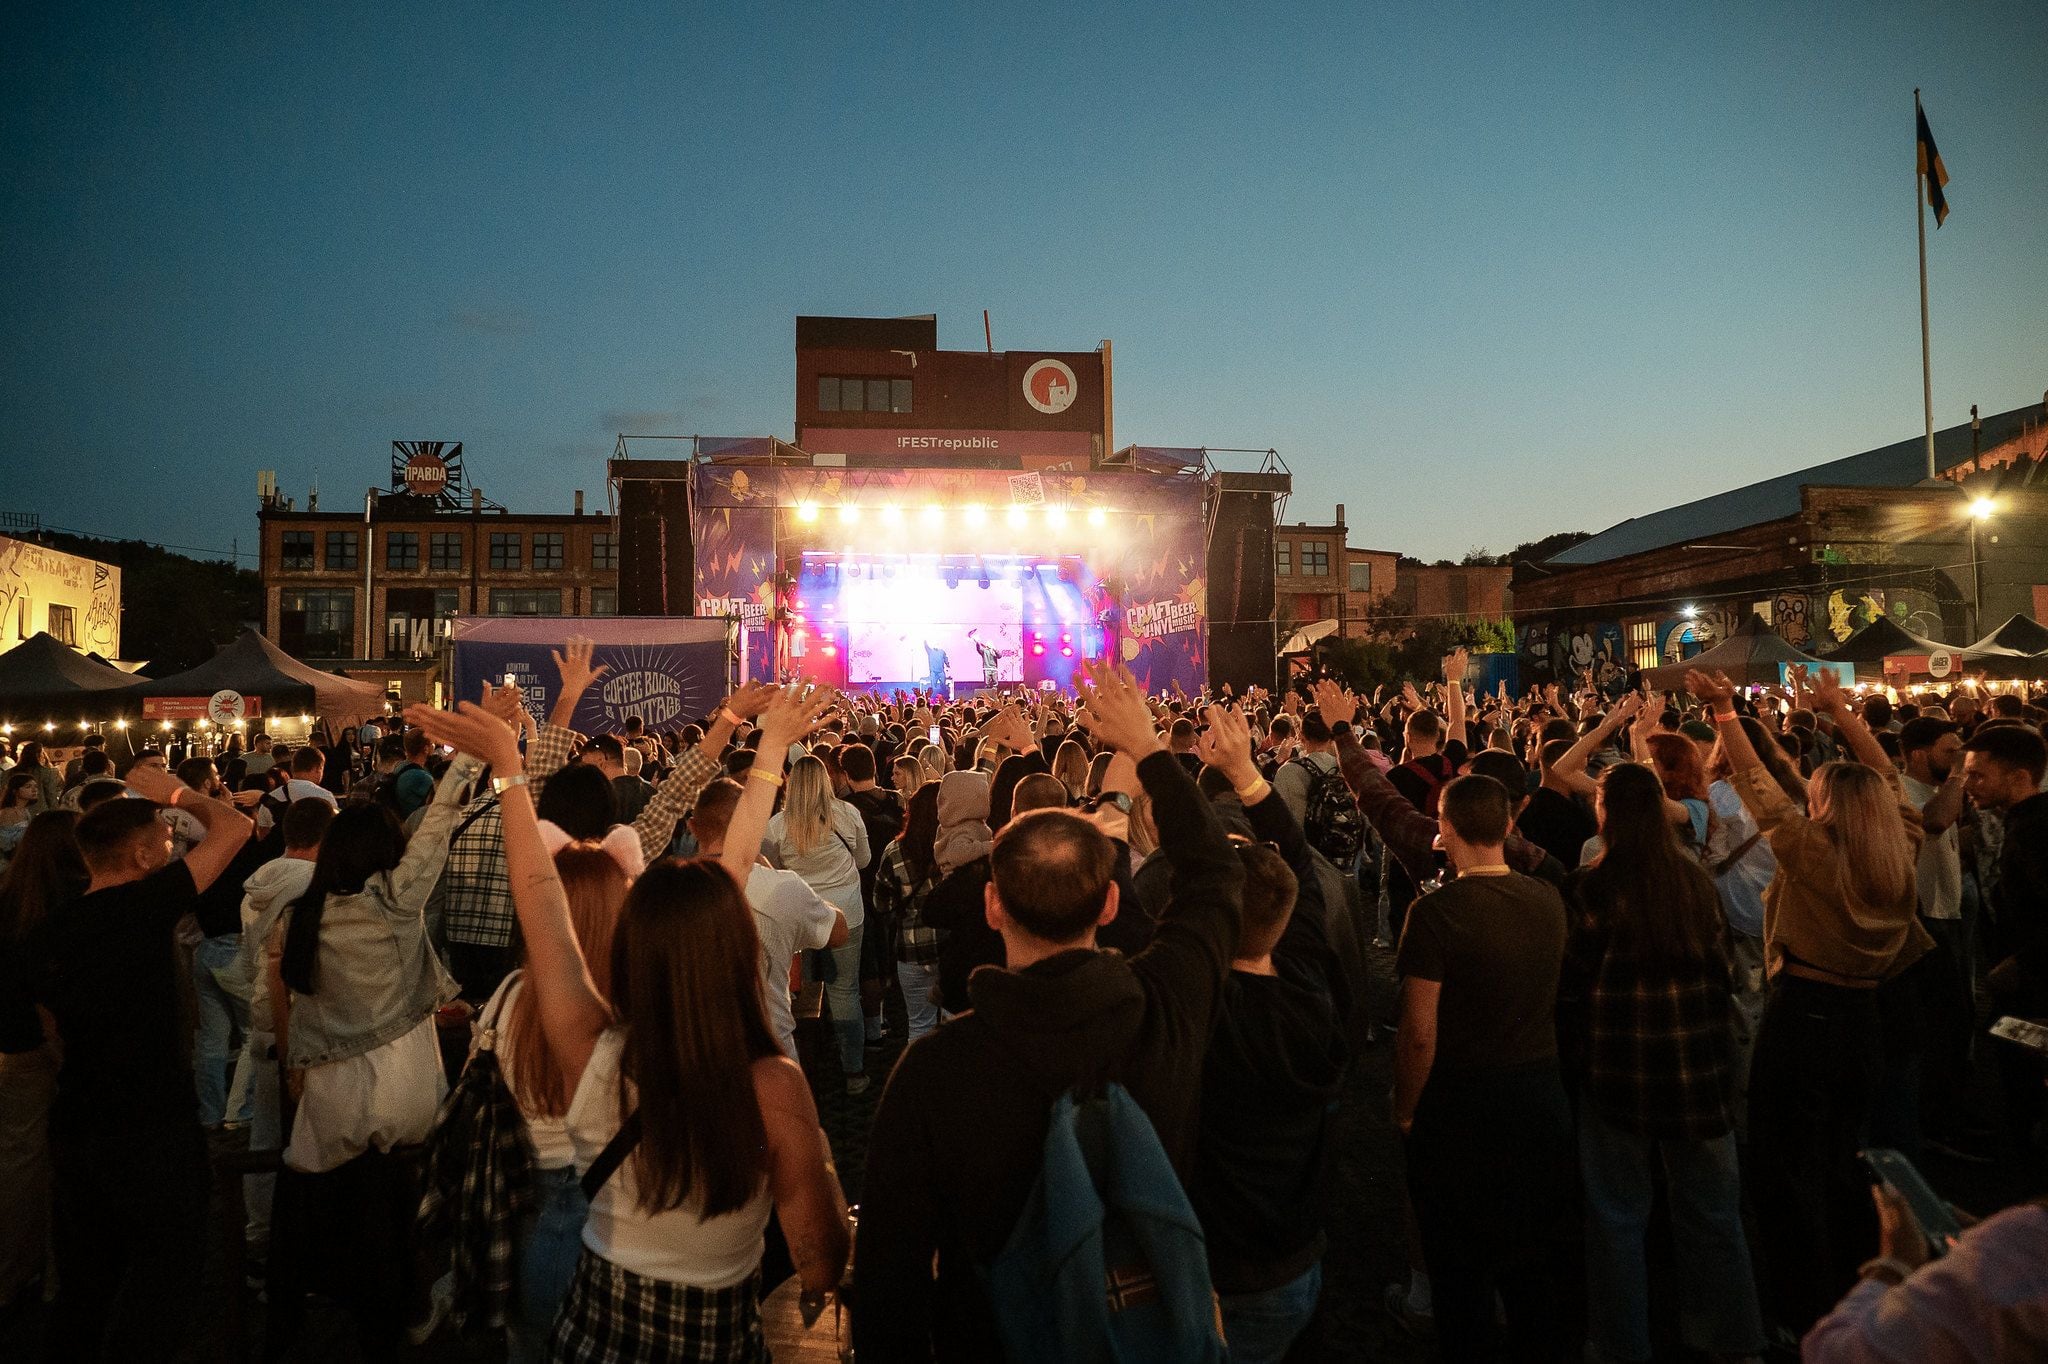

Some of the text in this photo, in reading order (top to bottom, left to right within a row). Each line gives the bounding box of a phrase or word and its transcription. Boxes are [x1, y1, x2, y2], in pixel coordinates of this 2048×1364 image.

[897, 437, 999, 450] !FESTrepublic
[743, 603, 767, 618] BEER
[1126, 599, 1173, 632] CRAFT
[1171, 601, 1197, 619] BEER
[745, 615, 766, 627] MUSIC
[1172, 613, 1195, 627] MUSIC
[603, 671, 681, 704] COFFEE BOOKS
[605, 696, 681, 726] & VINTAGE
